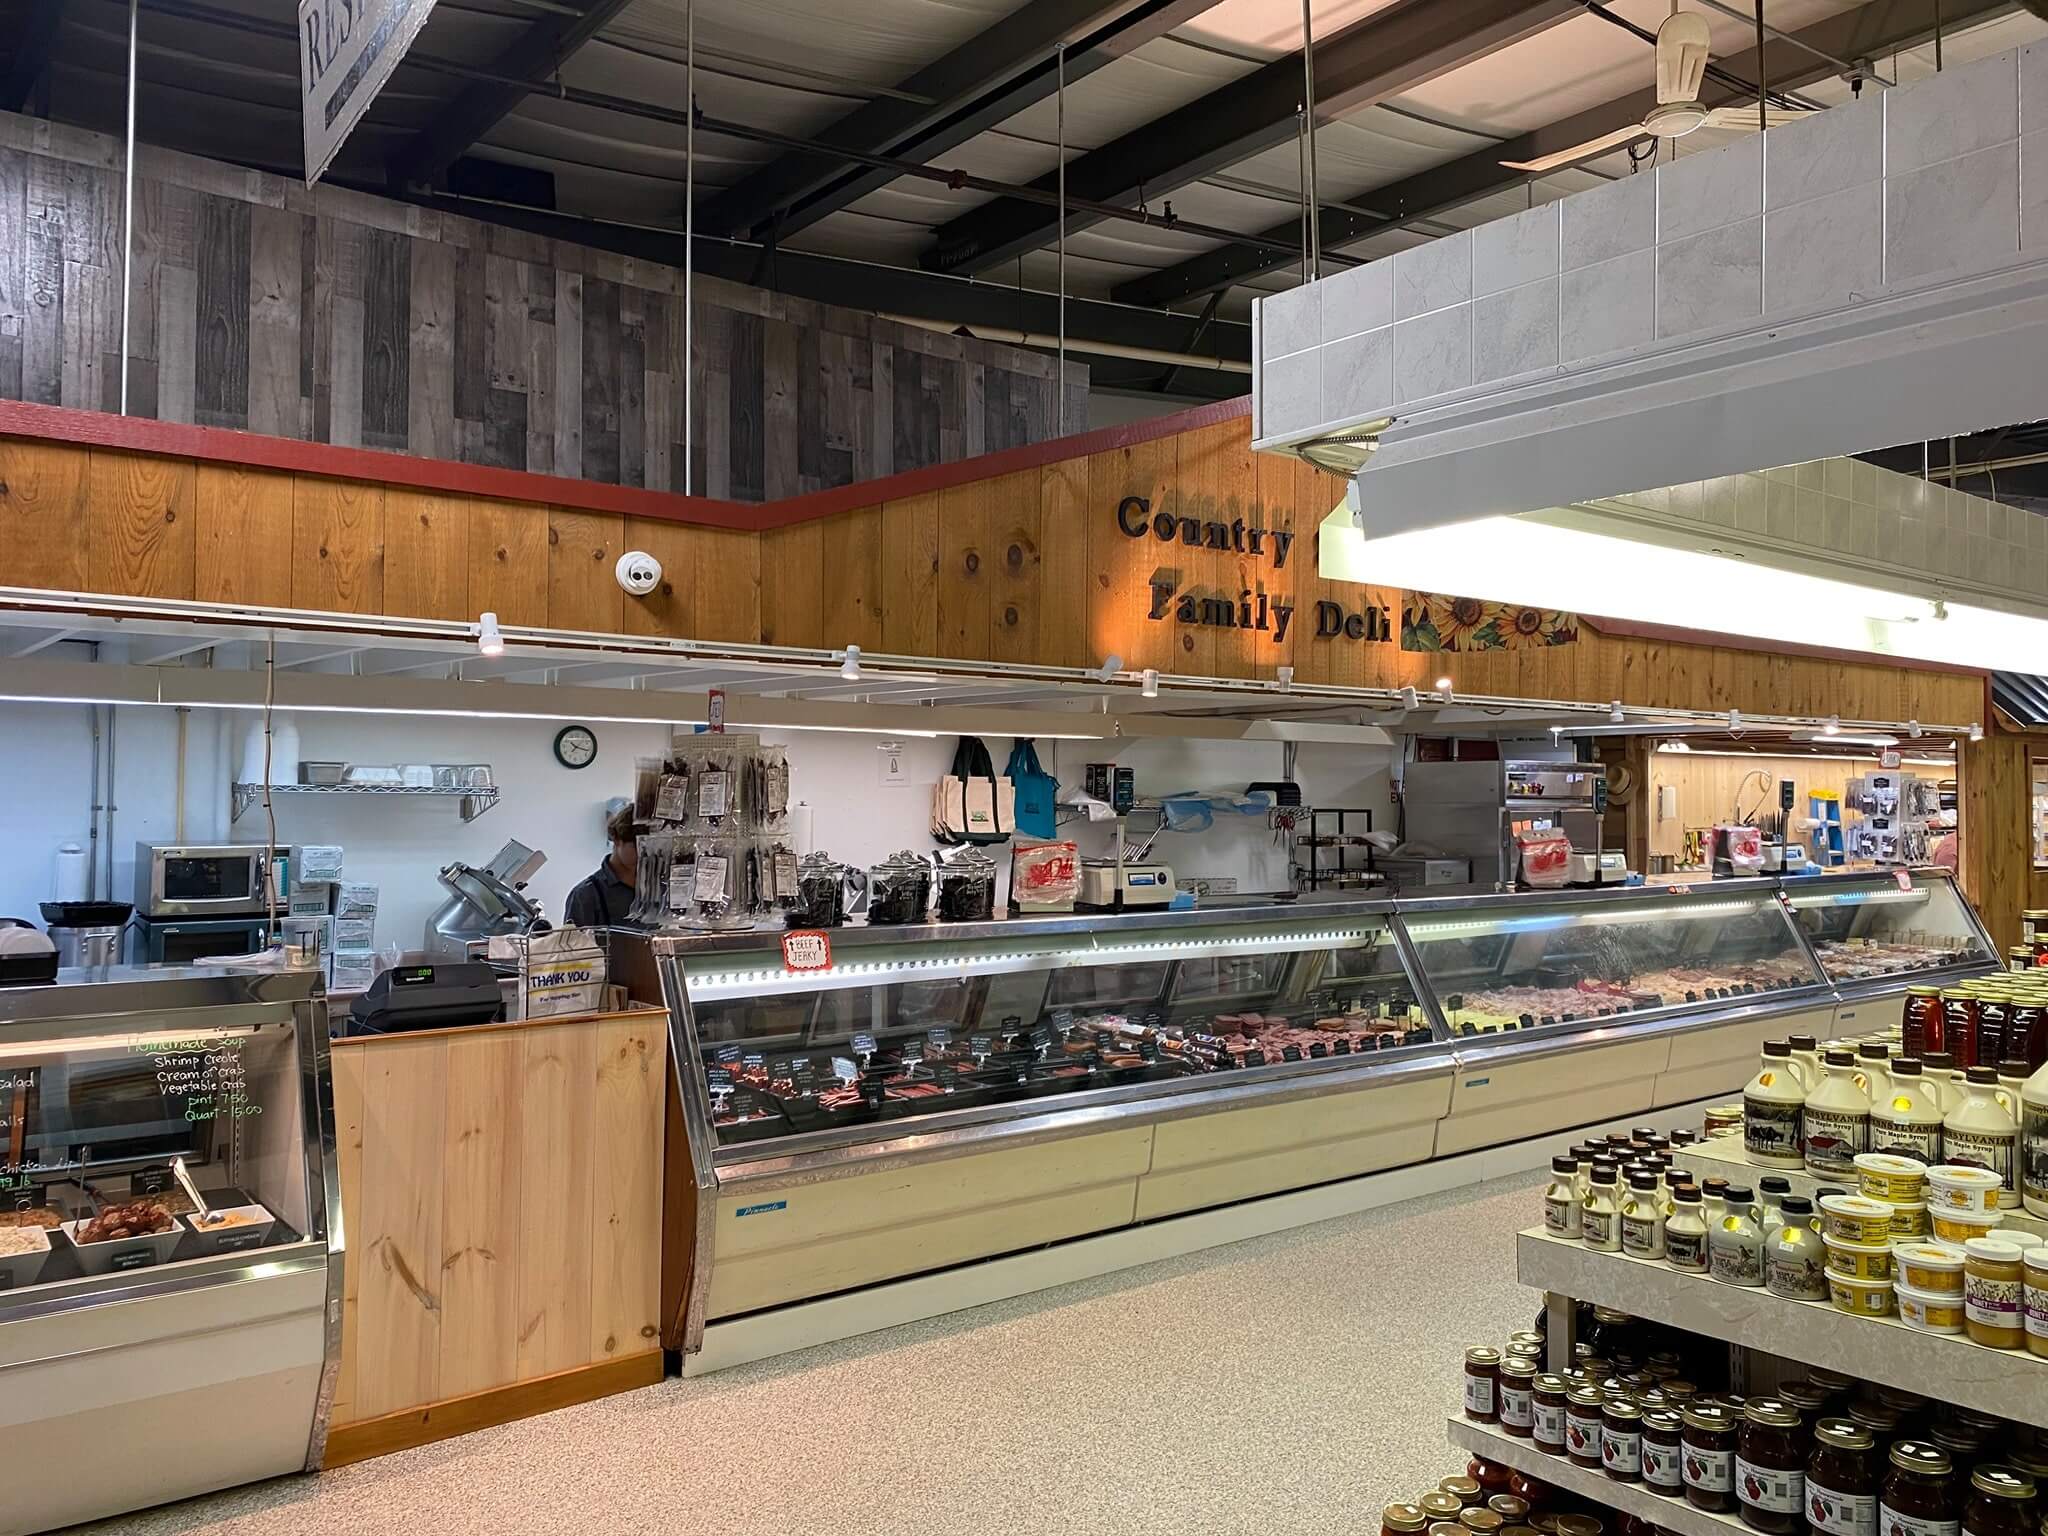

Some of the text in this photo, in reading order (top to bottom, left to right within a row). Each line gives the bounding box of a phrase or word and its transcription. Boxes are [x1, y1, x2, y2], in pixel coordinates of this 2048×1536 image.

[1117, 496, 1295, 568] Country
[1148, 581, 1393, 642] Family Deli
[796, 939, 814, 950] BEEF
[792, 950, 817, 962] JERKY
[530, 969, 590, 988] THANK YOU
[216, 1037, 247, 1049] Soup
[154, 1056, 200, 1069] Shrimp
[157, 1070, 200, 1082] Cream
[202, 1066, 218, 1078] of
[159, 1079, 217, 1096] Vegetable
[1833, 1123, 1852, 1131] Syrup
[1887, 1130, 1907, 1139] Maple
[1908, 1133, 1928, 1142] Syrup
[1972, 1144, 1993, 1153] Syrup
